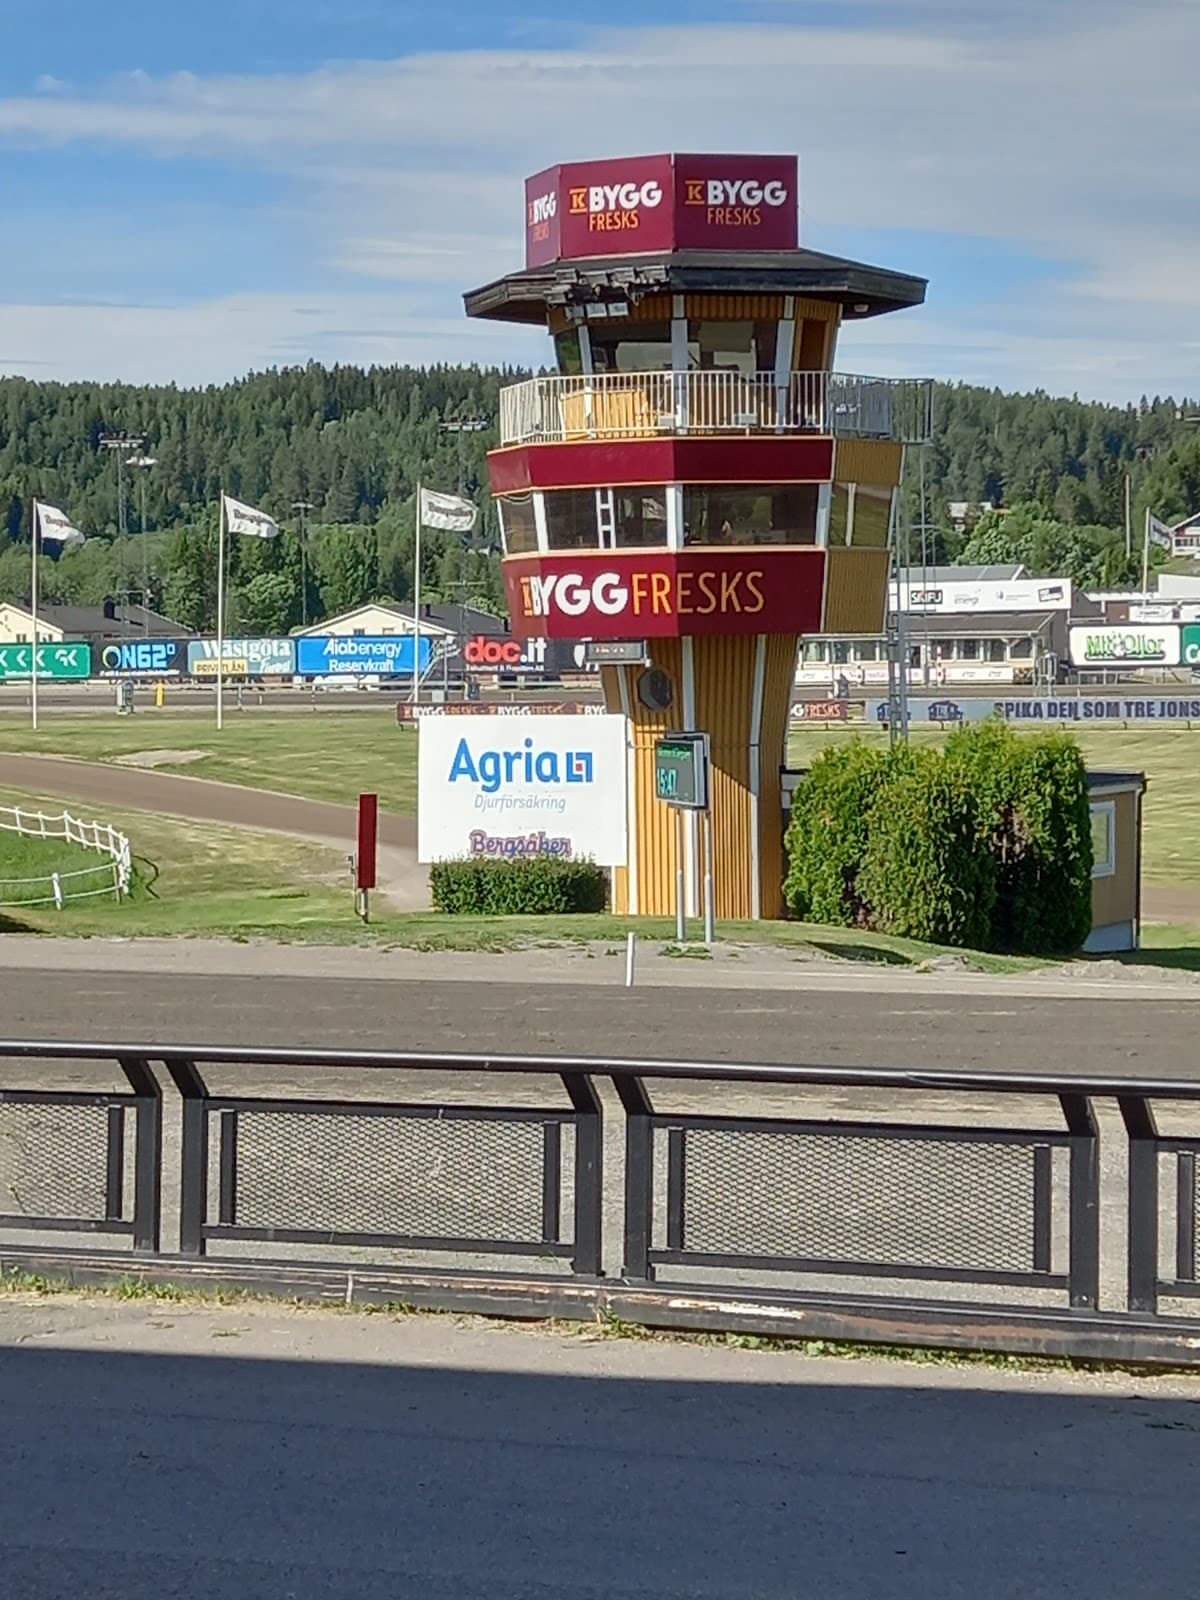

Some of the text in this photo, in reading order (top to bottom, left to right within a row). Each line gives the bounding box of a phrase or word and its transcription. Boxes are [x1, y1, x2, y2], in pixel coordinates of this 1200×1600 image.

[589, 181, 663, 213] BYGG
[707, 180, 788, 206] BYGG
[589, 209, 639, 231] FRESKS
[707, 207, 761, 226] FRESKS
[530, 572, 629, 617] BYGG
[631, 571, 766, 616] FRESKS
[464, 636, 547, 663] doc.it
[196, 661, 245, 673] PRIVTLÅN
[329, 659, 394, 672] Reservkraft
[994, 702, 1042, 718] SPIKA
[1047, 702, 1079, 718] DEN
[1083, 701, 1119, 718] SOM
[1125, 701, 1155, 718] TRE
[448, 738, 560, 793] Agria
[474, 793, 566, 813] Djurförsäkring
